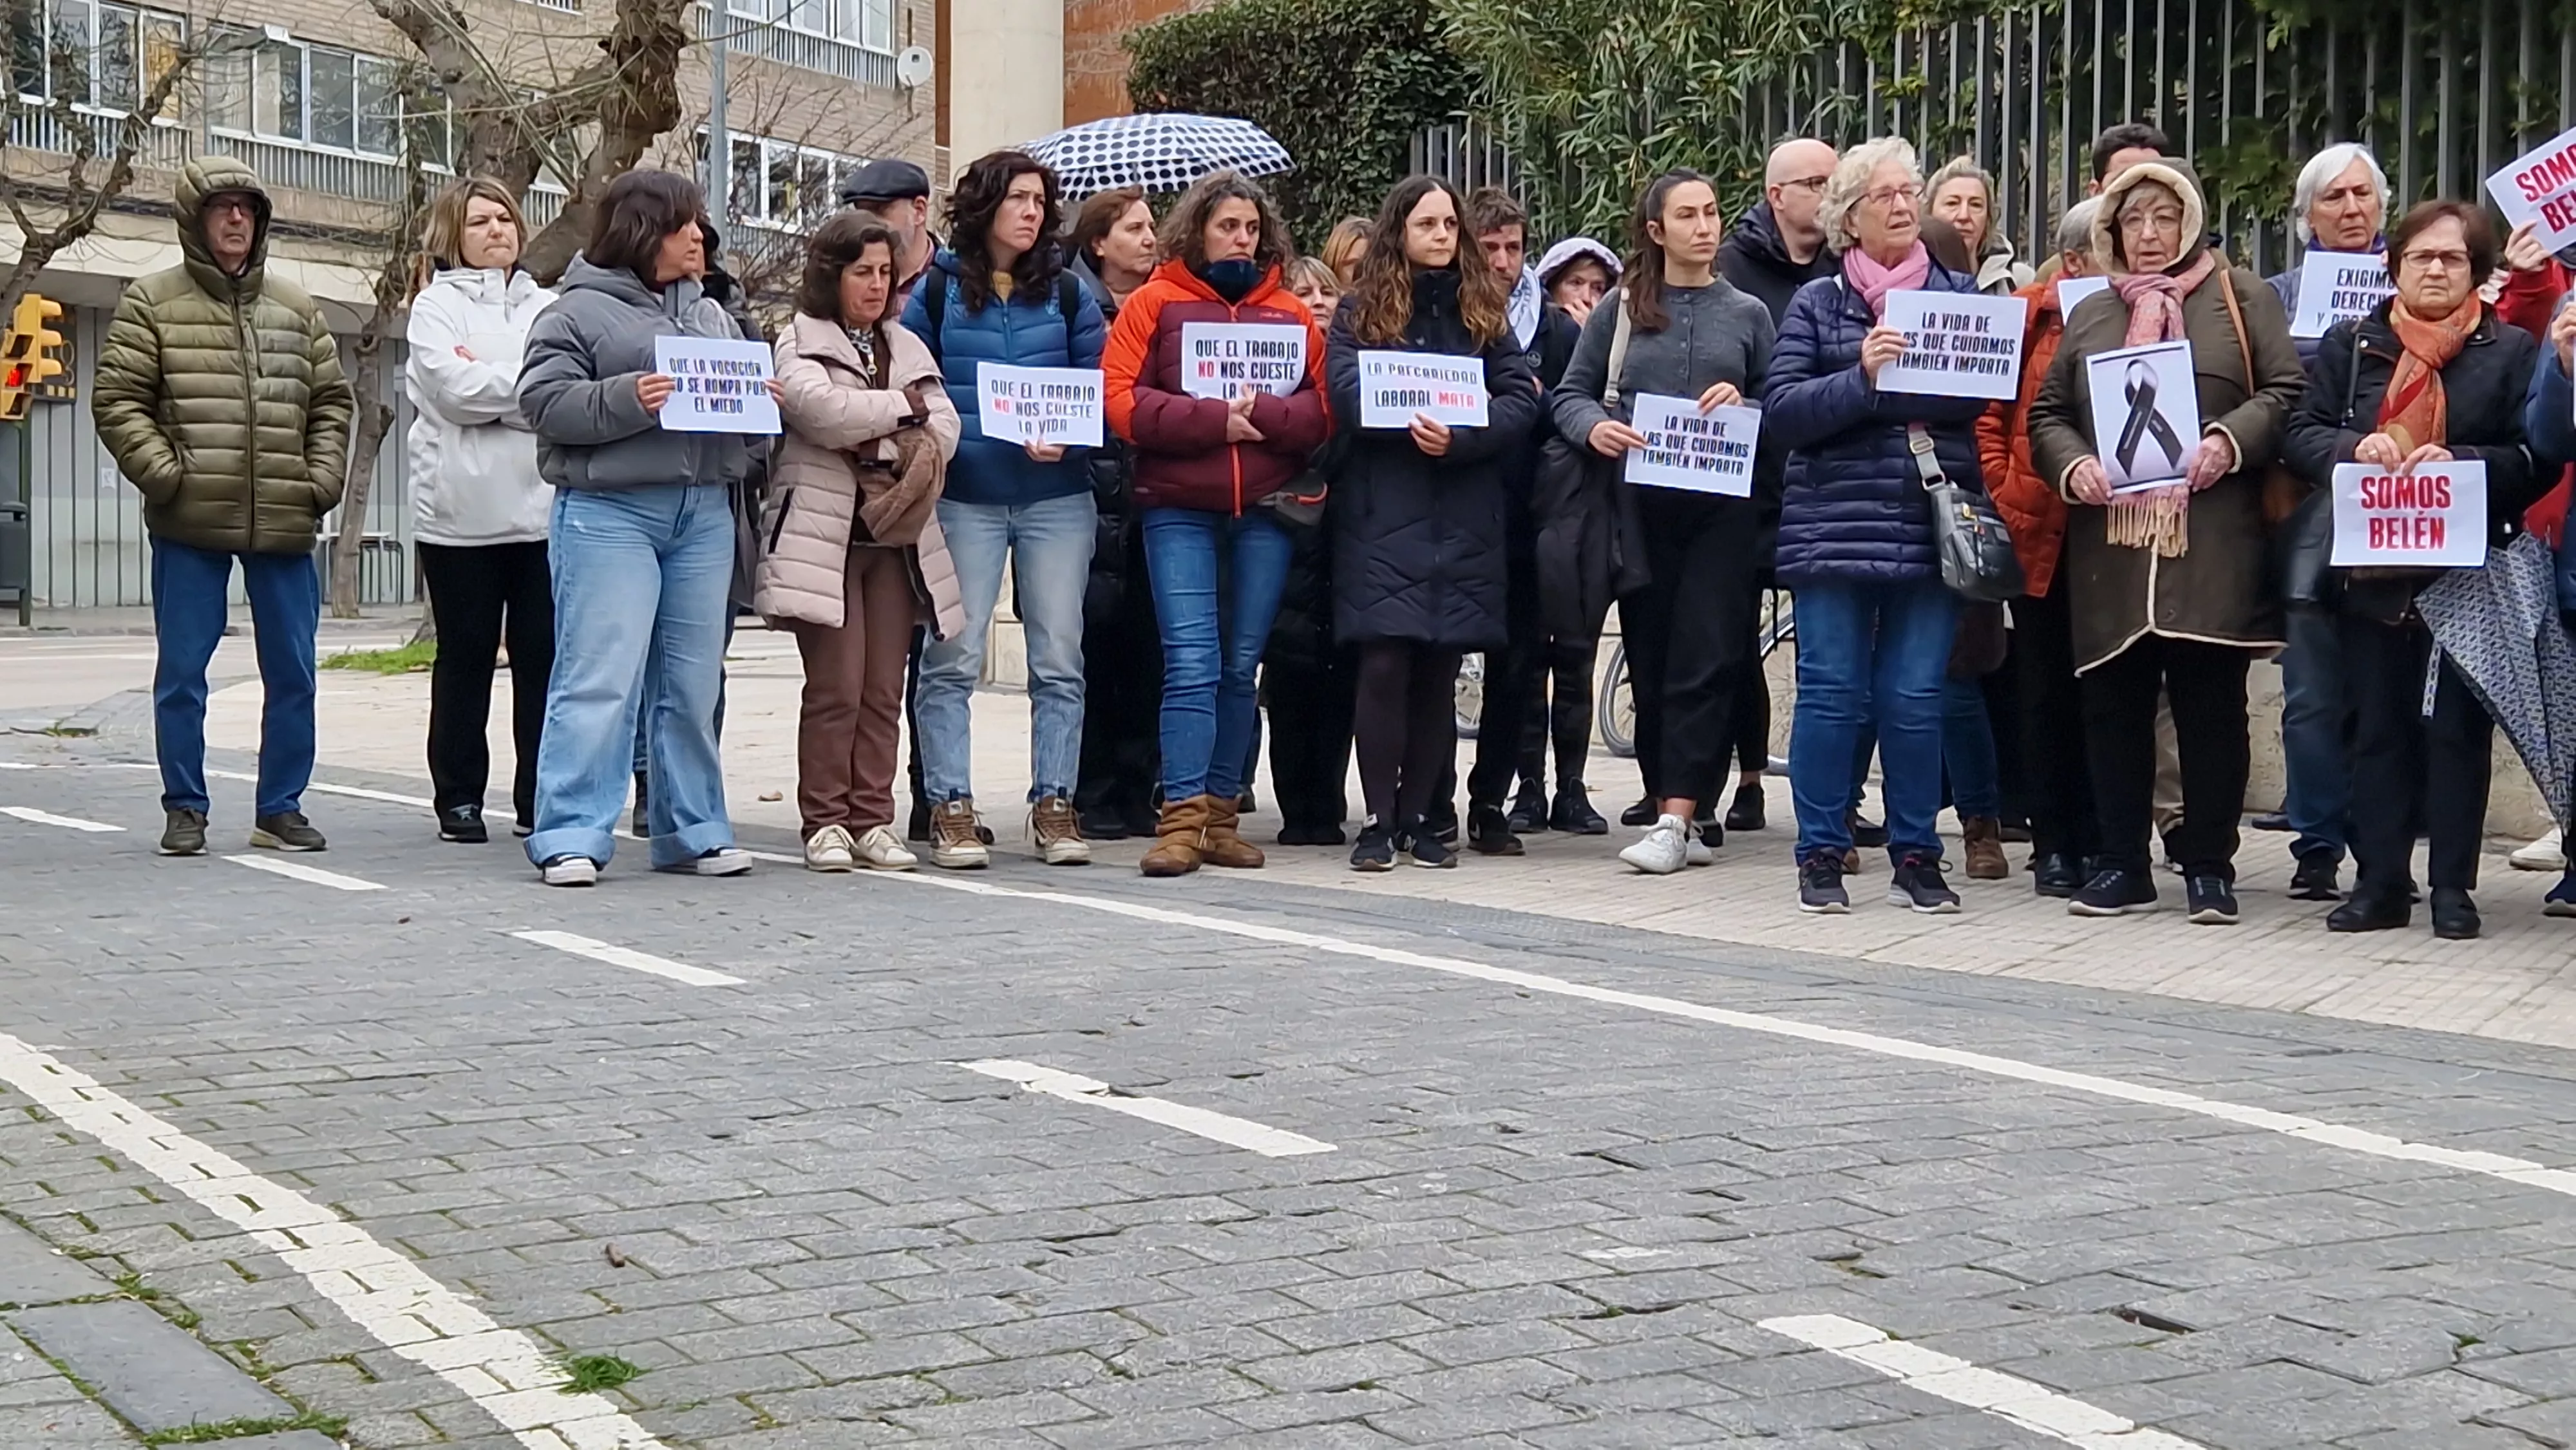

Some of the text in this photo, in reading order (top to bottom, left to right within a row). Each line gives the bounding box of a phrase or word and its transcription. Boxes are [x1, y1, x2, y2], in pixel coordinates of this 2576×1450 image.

[1922, 311, 1991, 333] LA VIDA DE
[2316, 312, 2325, 328] Y
[1196, 340, 1298, 361] QUE EL TRABAJO
[1923, 333, 1947, 351] QUE
[1951, 335, 2015, 355] CUIDAMOS
[669, 357, 762, 377] QUE LA VOCACIÓN
[1198, 361, 1296, 380] NO NOS CUESTE
[1367, 362, 1477, 384] LA PRECARIEDAD
[1955, 355, 2010, 376] IMPORTA
[688, 377, 701, 393] SE
[705, 378, 741, 395] ROMPA
[746, 379, 767, 395] POR
[991, 379, 1095, 402] QUE EL TRABAJO
[1223, 382, 1236, 399] LA
[694, 397, 743, 413] EL MIEDO
[994, 398, 1093, 419] NO NOS CUESTE
[1375, 390, 1475, 408] LABORAL MATA
[1018, 419, 1067, 435] LA VIDA
[1665, 415, 1727, 437] LA VIDA DE
[1666, 433, 1687, 450] QUE
[1691, 437, 1749, 458] CUIDAMOS
[1642, 448, 1744, 476] TAMBIÉN IMPORTA
[2361, 475, 2450, 509] SOMOS
[2369, 511, 2445, 549] BELÉN
